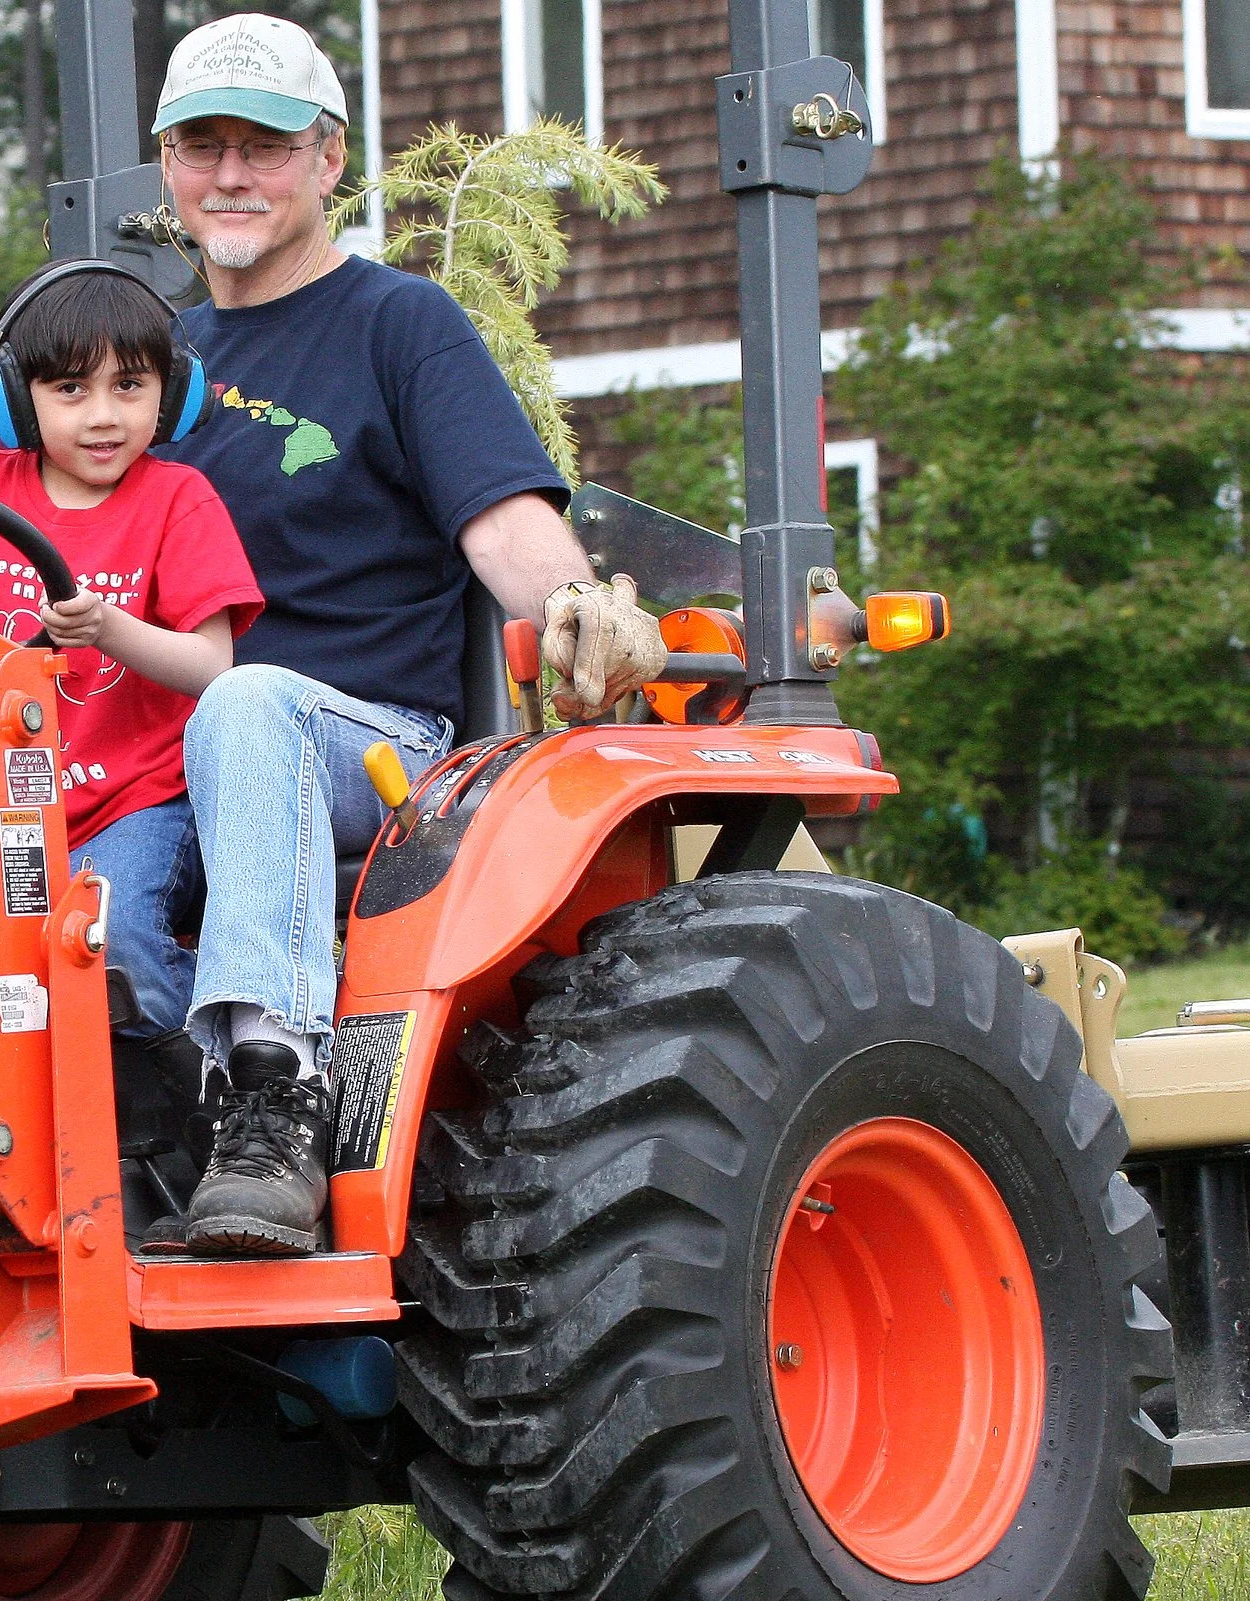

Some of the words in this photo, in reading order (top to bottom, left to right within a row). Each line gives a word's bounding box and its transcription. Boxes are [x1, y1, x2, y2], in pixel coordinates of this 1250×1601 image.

[187, 32, 235, 69] COUNTRY
[239, 32, 283, 70] TRACTOR
[14, 754, 43, 765] Kubota
[8, 813, 40, 823] WARNING
[384, 1061, 404, 1129] CAUTION
